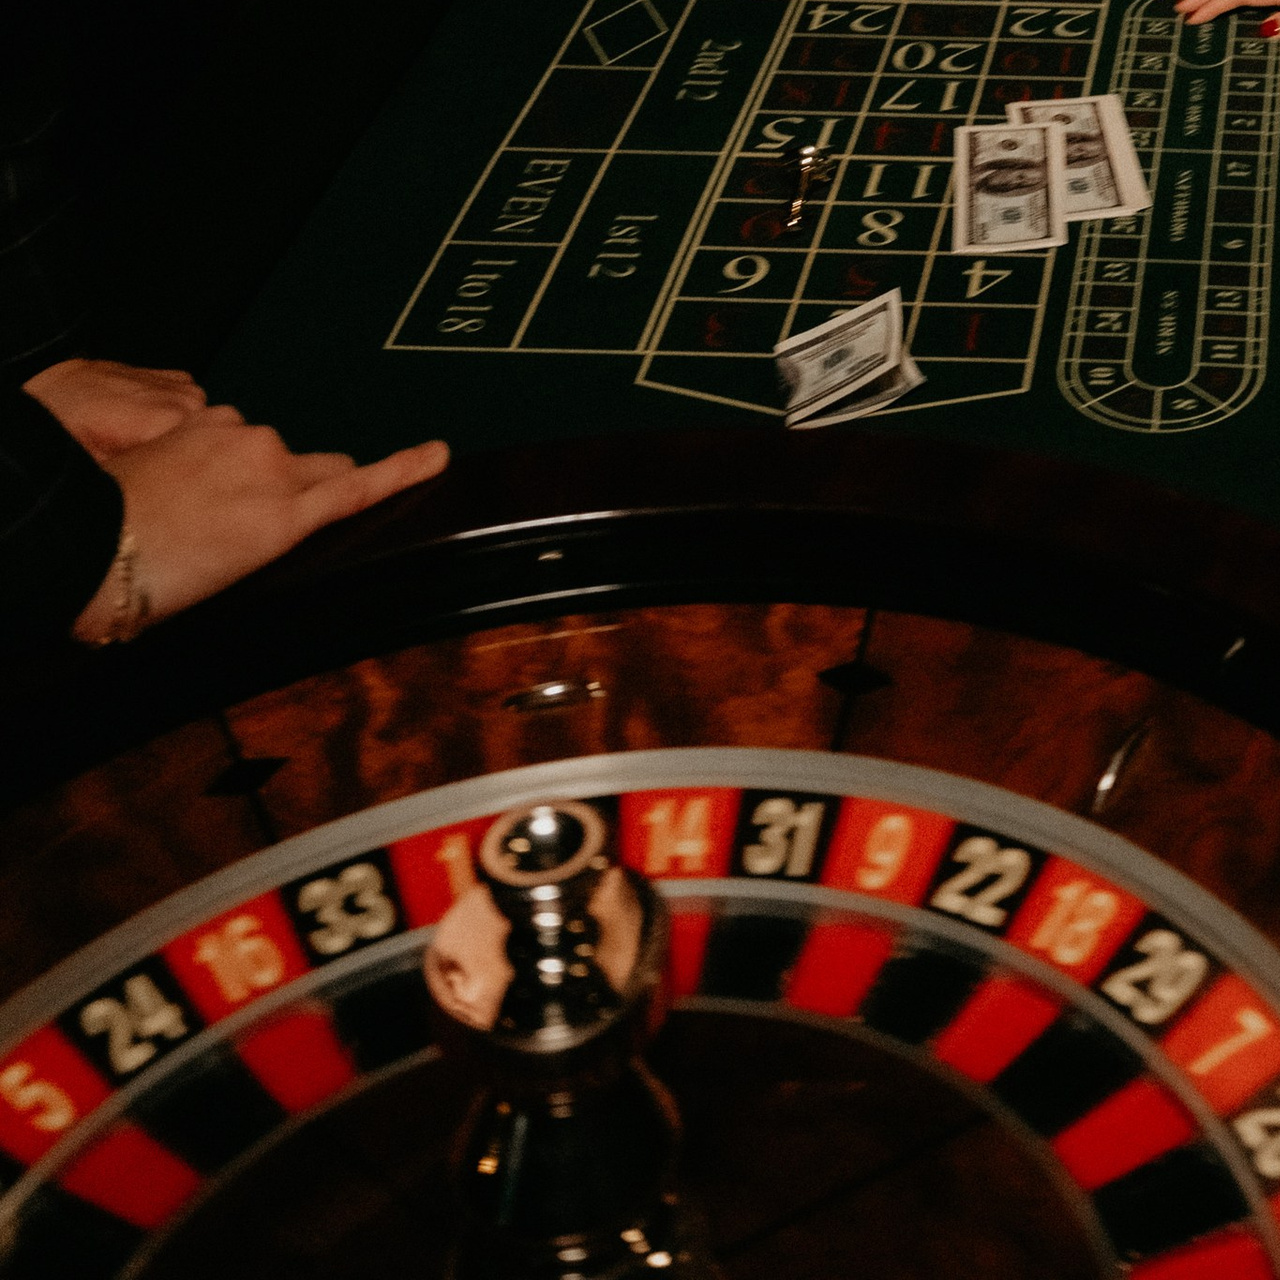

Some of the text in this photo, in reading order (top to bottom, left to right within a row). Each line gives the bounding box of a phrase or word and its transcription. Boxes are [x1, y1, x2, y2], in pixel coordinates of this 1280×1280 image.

[806, 2, 897, 33] 24
[1008, 7, 1098, 38] 22
[891, 41, 985, 74] 20
[878, 80, 965, 113] 17
[753, 115, 844, 150] 15
[490, 158, 573, 234] EVEN
[862, 163, 938, 200] 11
[855, 208, 906, 248] 8
[717, 253, 772, 295] 6
[962, 259, 1015, 300] 4
[965, 313, 983, 351] 1
[0, 1058, 78, 1134] 5
[78, 970, 190, 1078] 24
[192, 910, 289, 1007] 16
[296, 859, 399, 958] 33
[640, 797, 713, 877] 14
[741, 795, 828, 880] 31
[853, 813, 914, 892] 9
[929, 835, 1038, 929] 22
[1030, 878, 1122, 967] 18
[1099, 927, 1211, 1027] 29
[1187, 1007, 1275, 1078] 7
